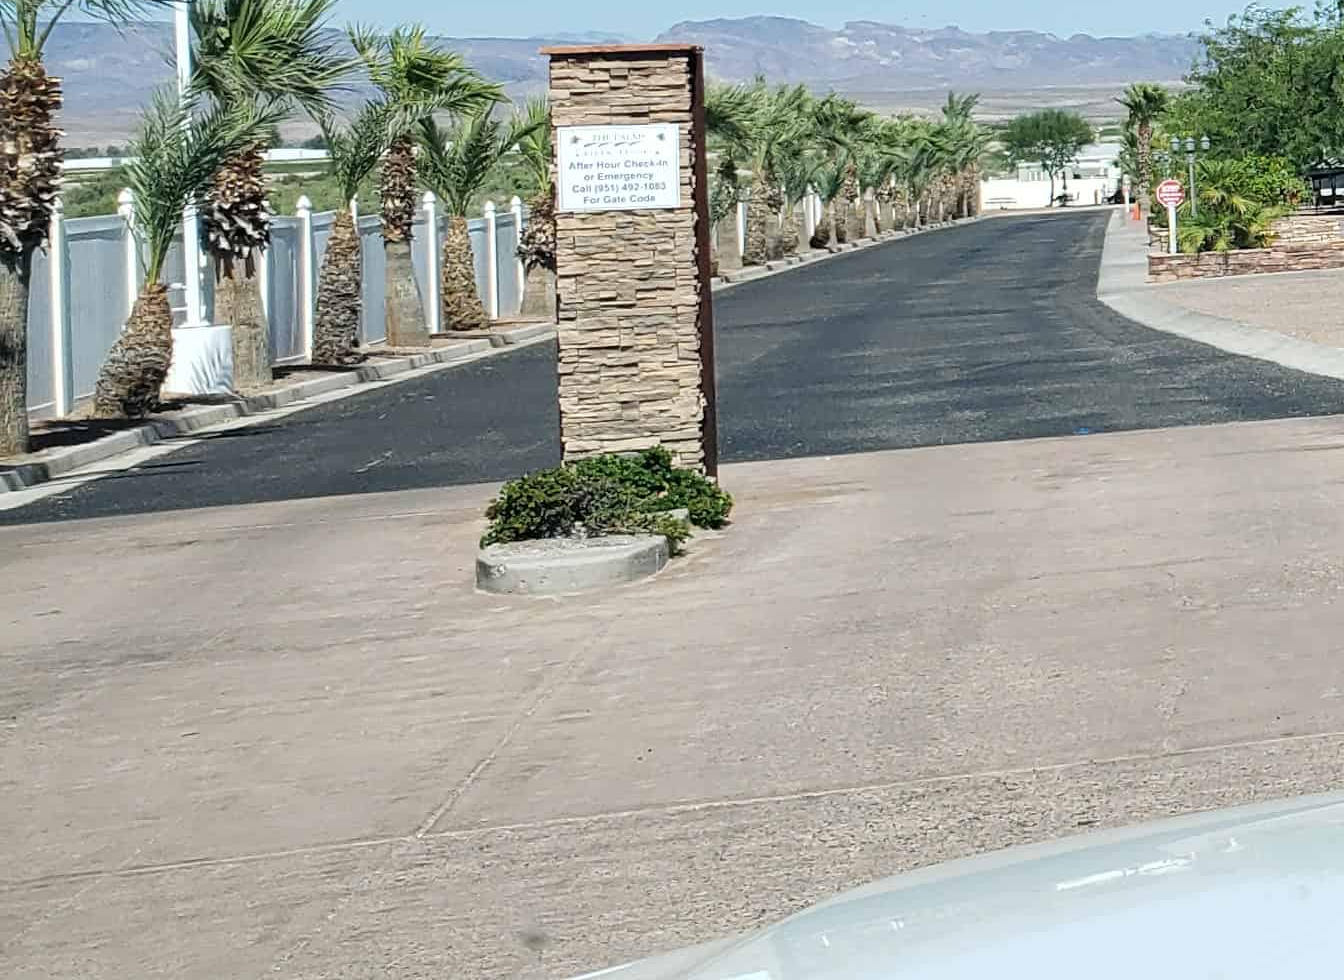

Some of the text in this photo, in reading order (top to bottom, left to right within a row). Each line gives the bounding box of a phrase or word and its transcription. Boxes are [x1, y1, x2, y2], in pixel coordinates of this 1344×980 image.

[569, 161, 594, 170] After
[597, 161, 620, 169] Hour
[598, 172, 654, 181] Emergency
[572, 184, 592, 193] Call
[584, 194, 656, 204] For Gate Code
